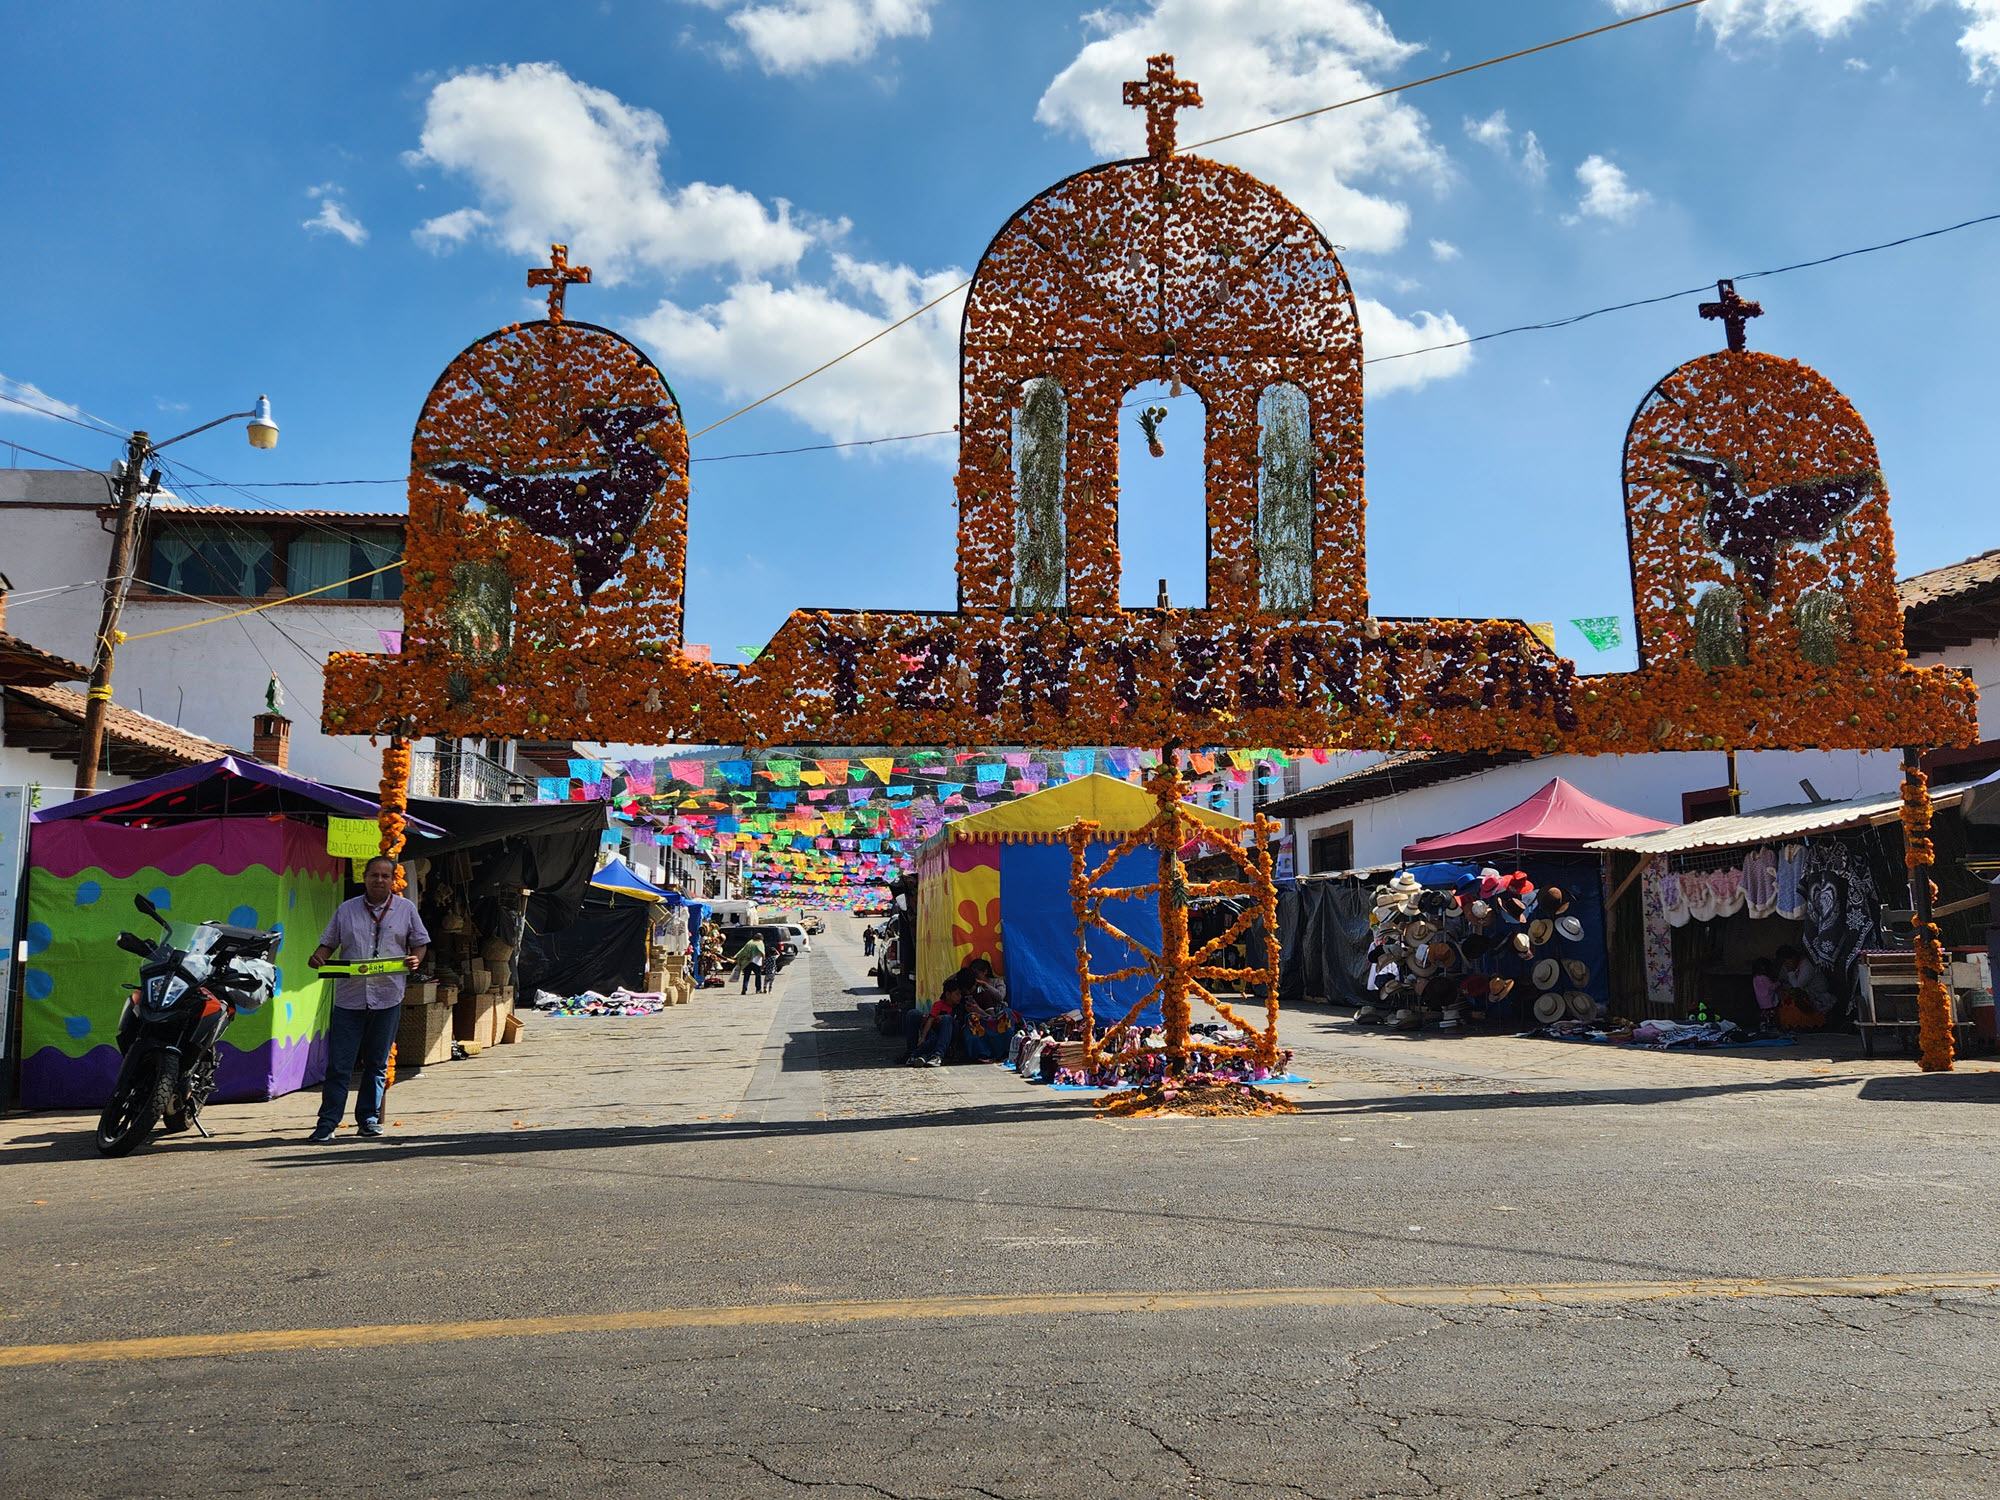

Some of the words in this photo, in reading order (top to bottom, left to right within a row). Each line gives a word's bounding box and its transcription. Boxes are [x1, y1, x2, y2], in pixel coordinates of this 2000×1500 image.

[329, 817, 376, 836] MICHELADAS
[344, 832, 351, 841] Y
[328, 841, 379, 857] CANTARITOS
